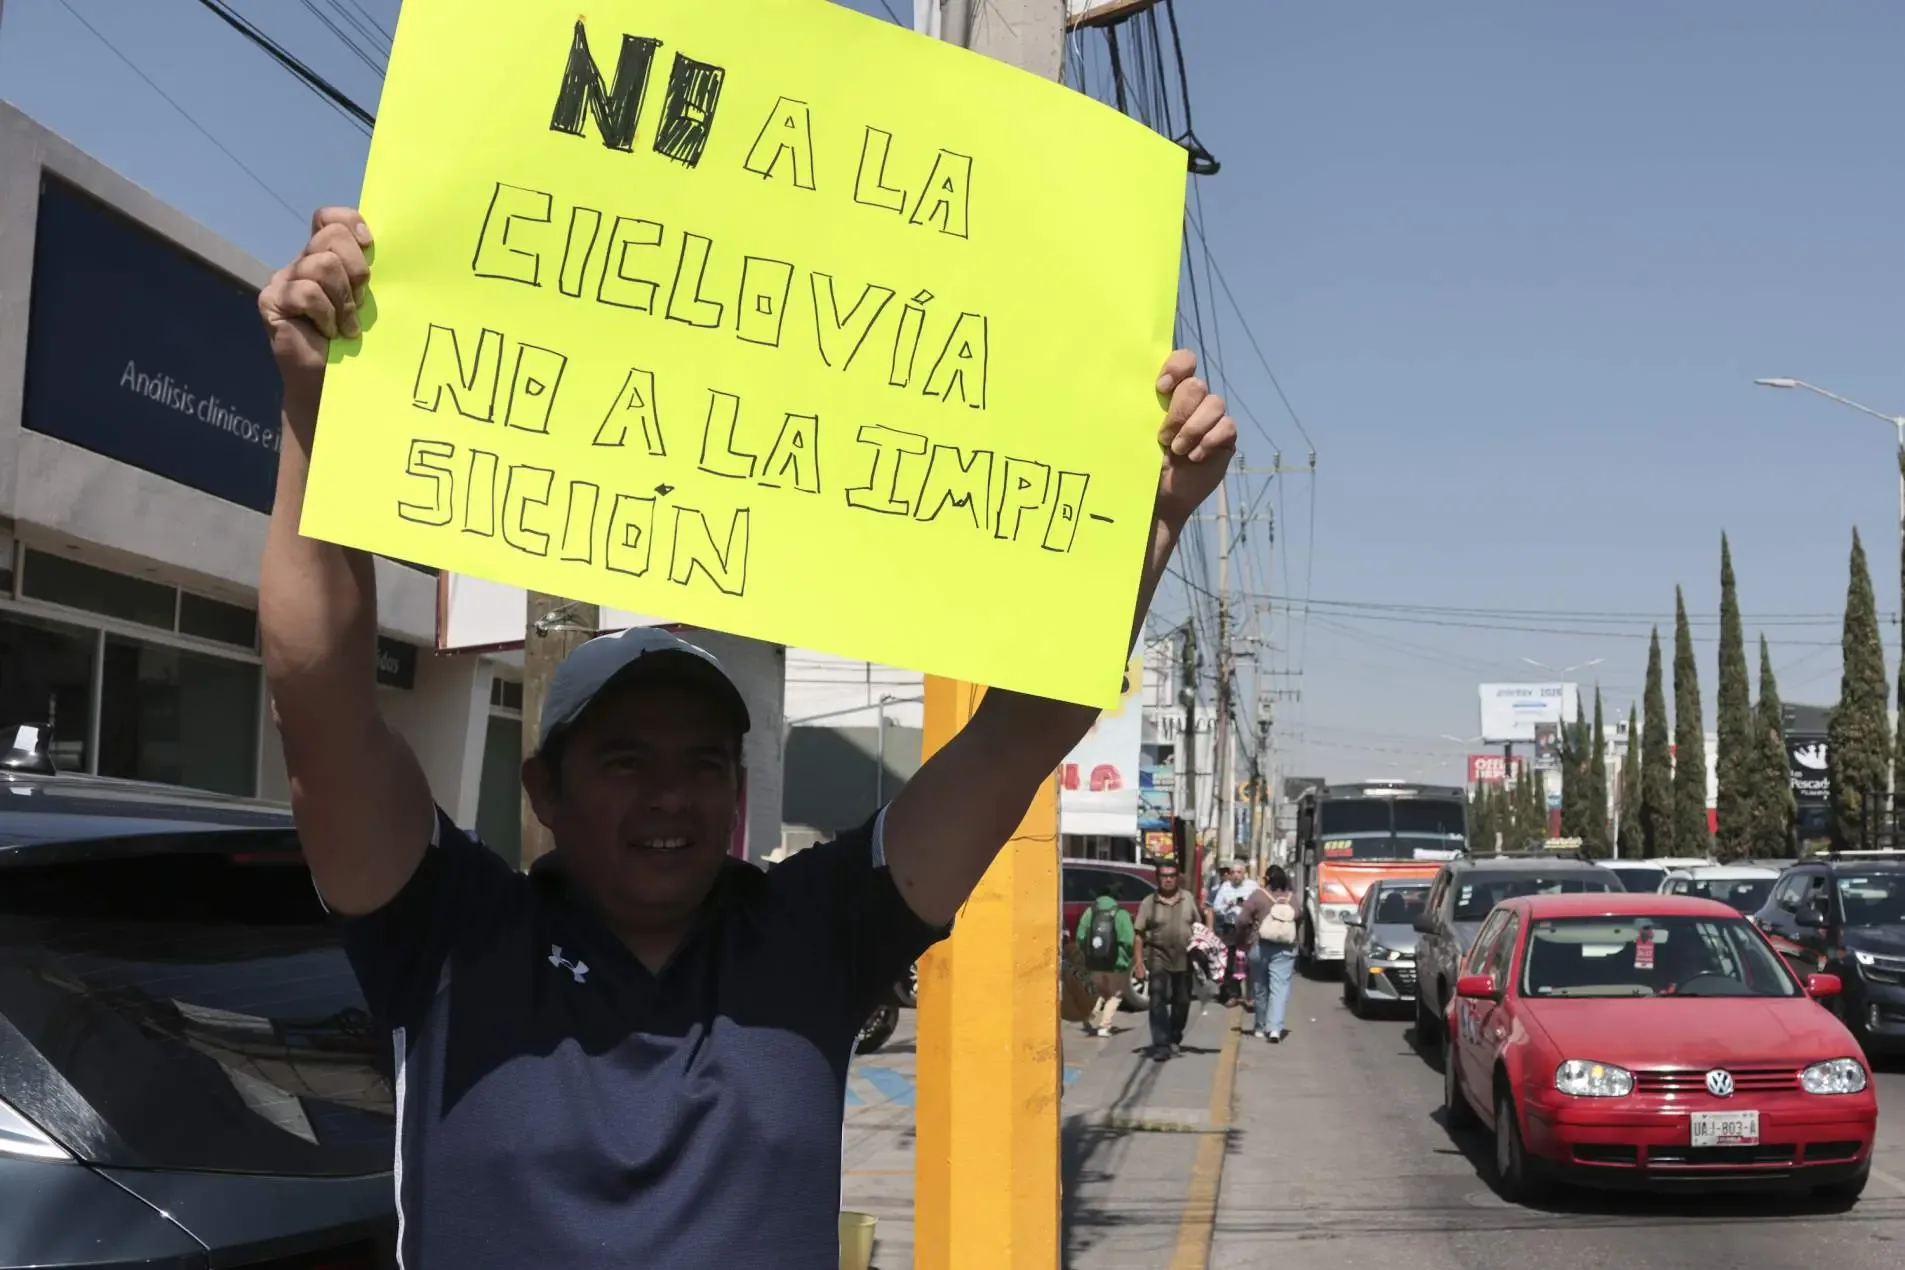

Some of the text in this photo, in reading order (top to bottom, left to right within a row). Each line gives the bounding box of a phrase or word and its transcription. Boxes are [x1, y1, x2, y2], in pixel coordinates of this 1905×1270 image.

[549, 20, 972, 239] NO A LA
[472, 182, 988, 410] CICLOVÍA
[120, 359, 196, 415] Análisis
[197, 395, 260, 443] clínicos
[262, 428, 273, 448] e
[412, 323, 568, 434] NO
[592, 368, 667, 456] A
[697, 386, 820, 494] LA
[398, 439, 750, 597] SICIÓN
